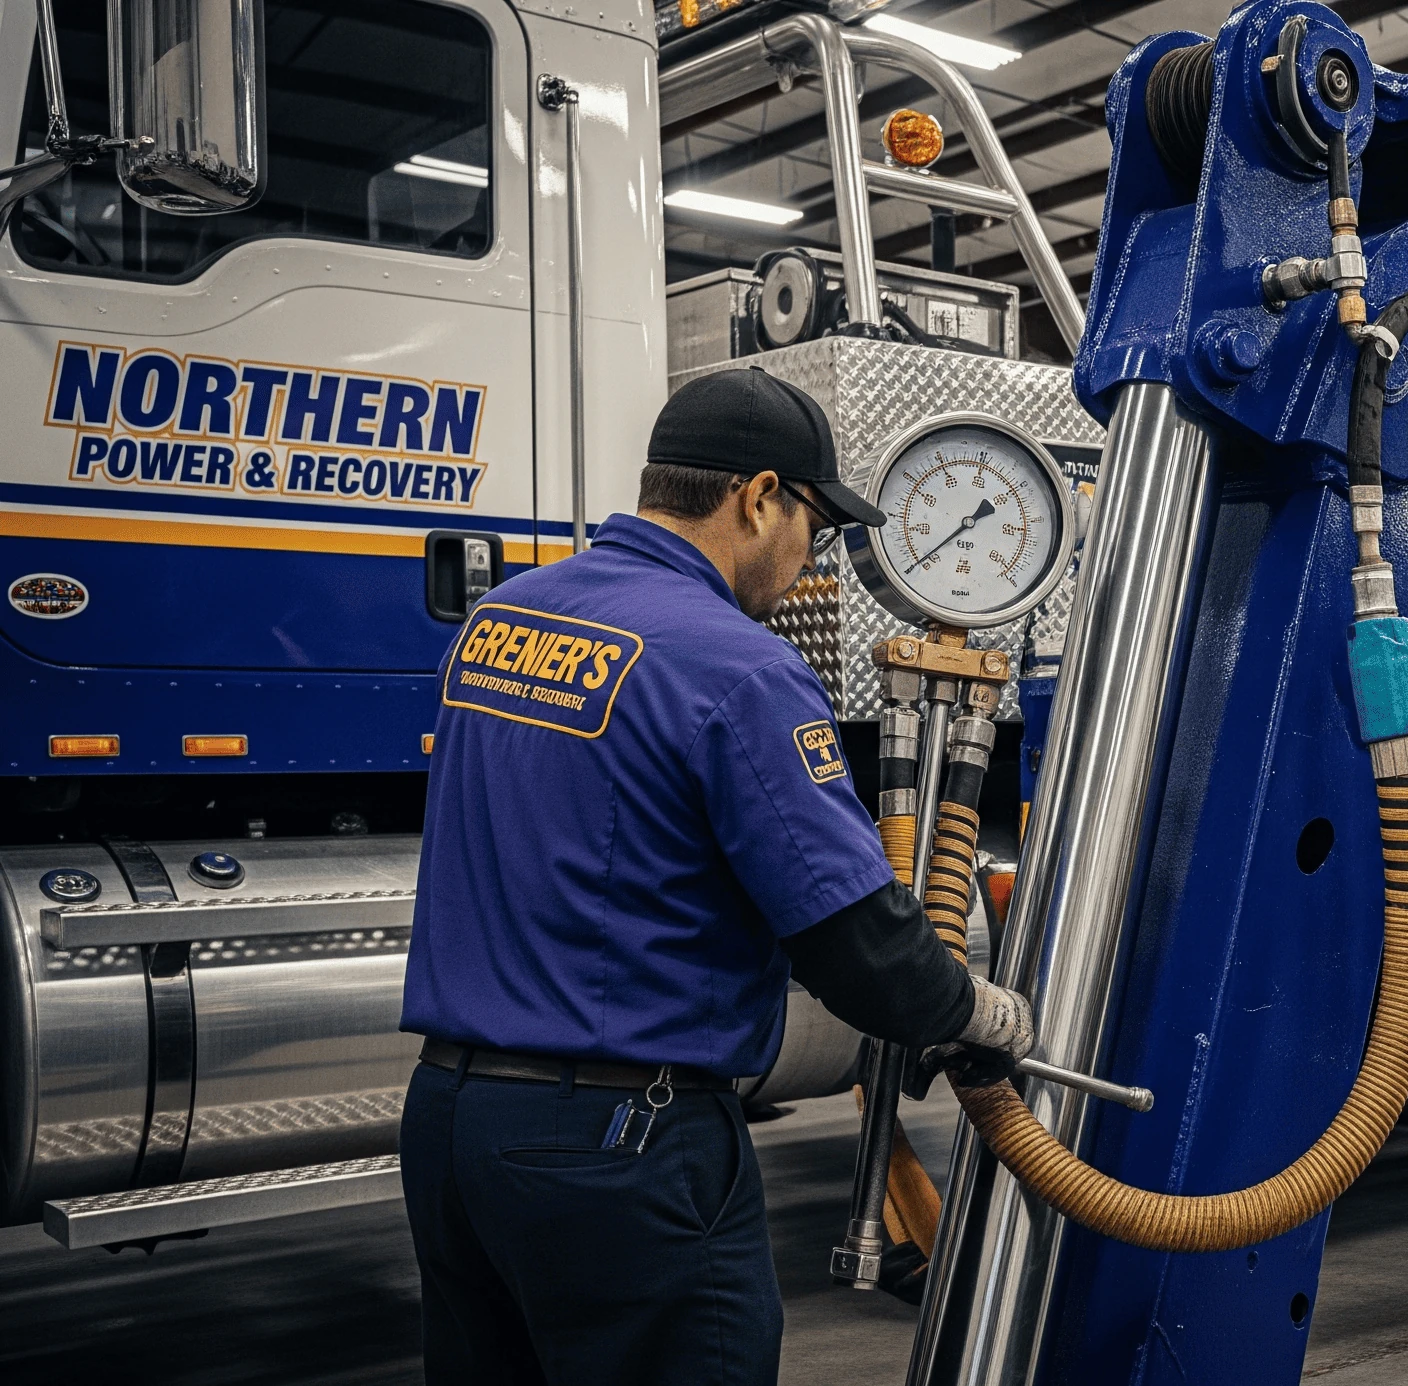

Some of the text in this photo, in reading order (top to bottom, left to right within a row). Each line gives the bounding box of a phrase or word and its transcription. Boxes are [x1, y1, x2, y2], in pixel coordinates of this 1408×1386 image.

[50, 345, 485, 457] NORTHERN
[75, 435, 482, 504] POWER & RECOVERY
[460, 618, 622, 690] GRENIER'S
